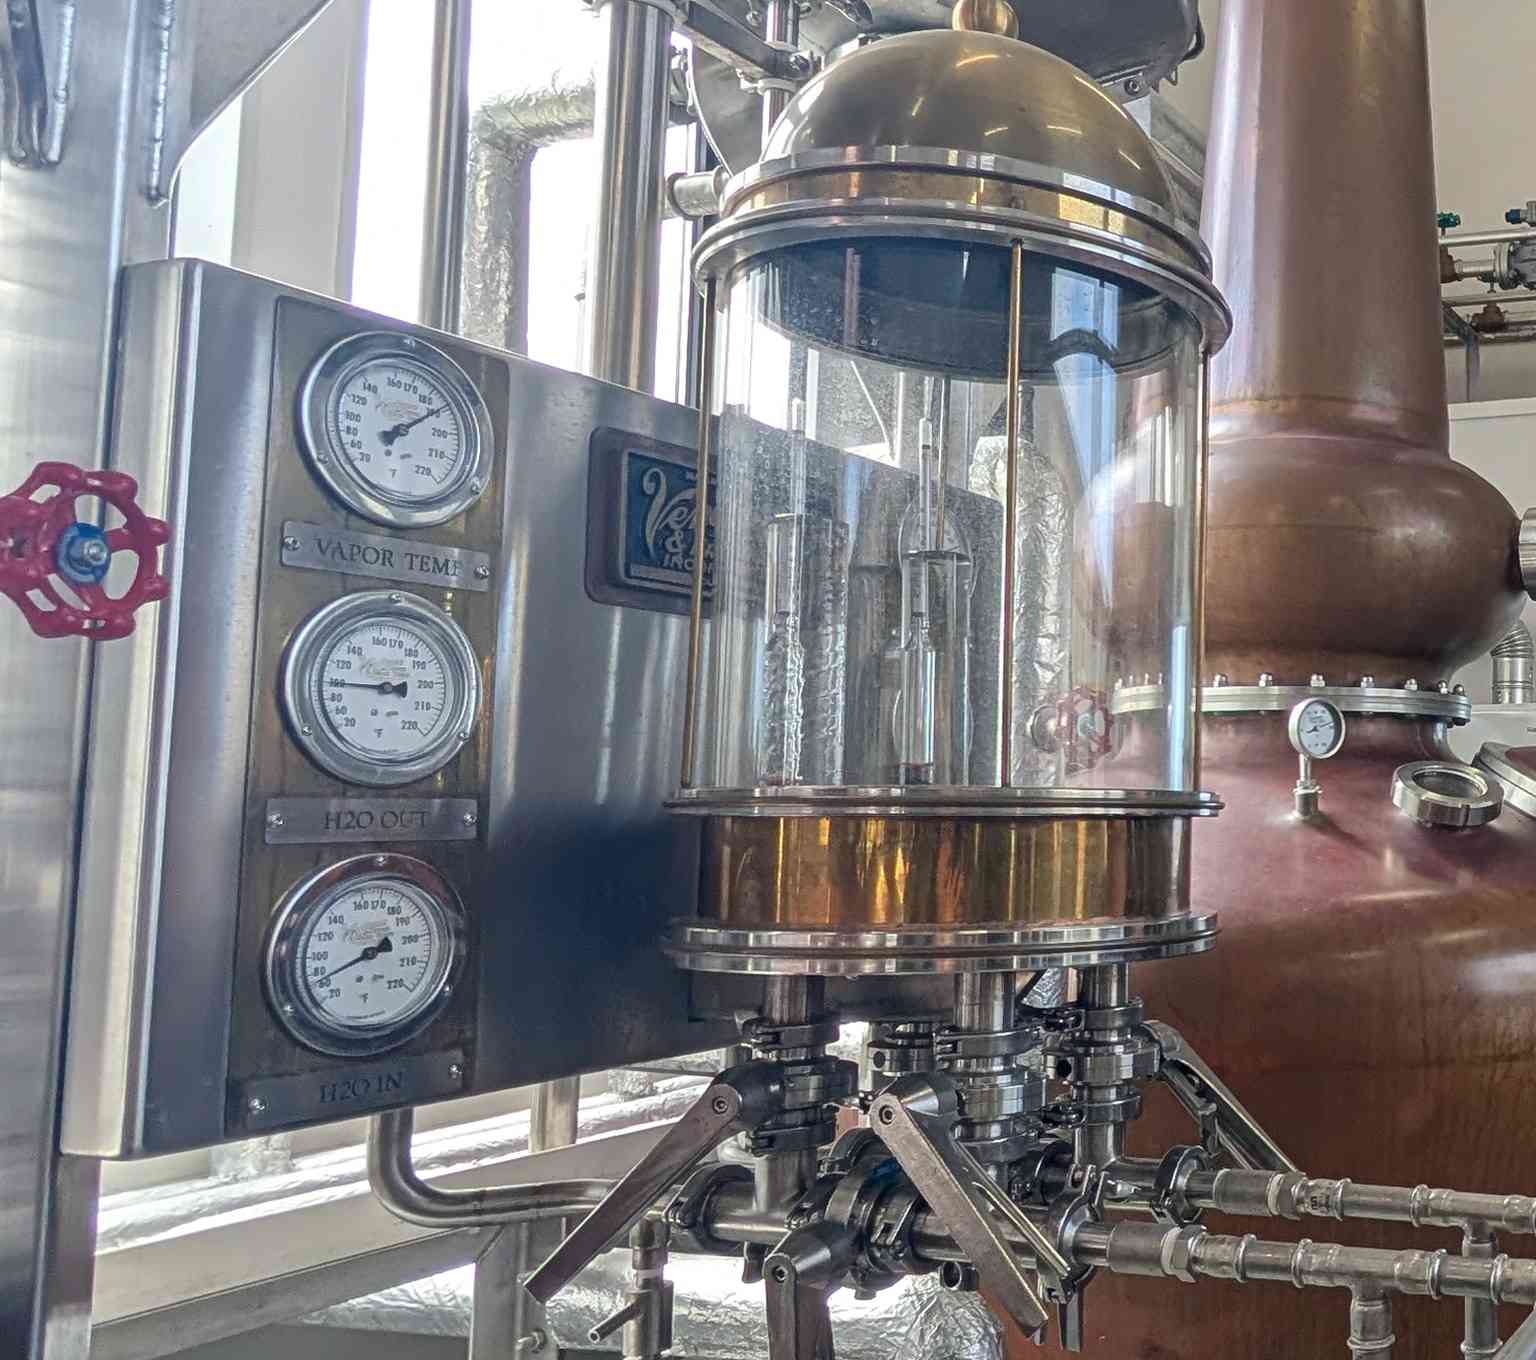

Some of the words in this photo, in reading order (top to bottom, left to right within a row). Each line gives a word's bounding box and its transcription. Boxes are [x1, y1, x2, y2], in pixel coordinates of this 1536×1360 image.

[431, 427, 448, 439] 200
[316, 538, 394, 568] VAPOR
[417, 680, 434, 689] 200
